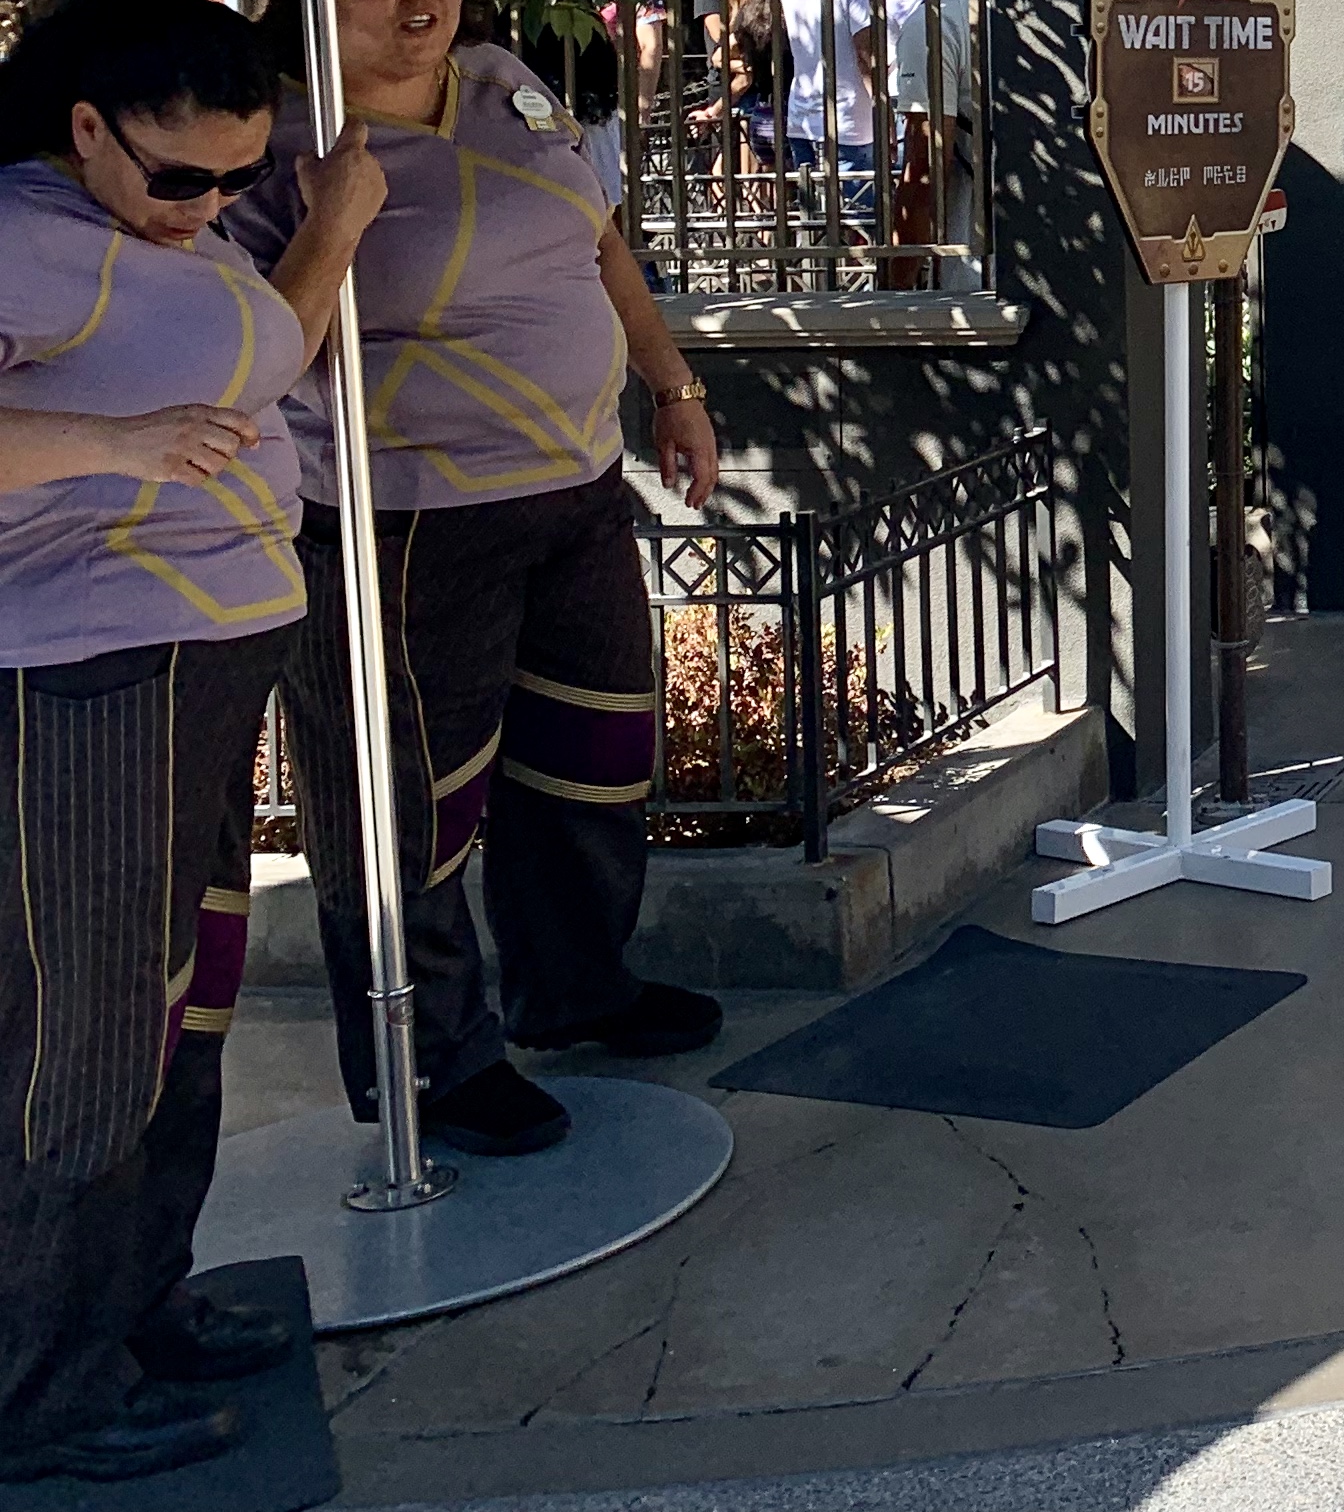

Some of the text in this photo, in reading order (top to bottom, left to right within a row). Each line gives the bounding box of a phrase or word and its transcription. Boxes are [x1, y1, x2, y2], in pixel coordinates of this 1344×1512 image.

[1117, 14, 1273, 50] WAIT TIME
[1186, 72, 1205, 93] 15
[1147, 112, 1244, 135] MINUTES
